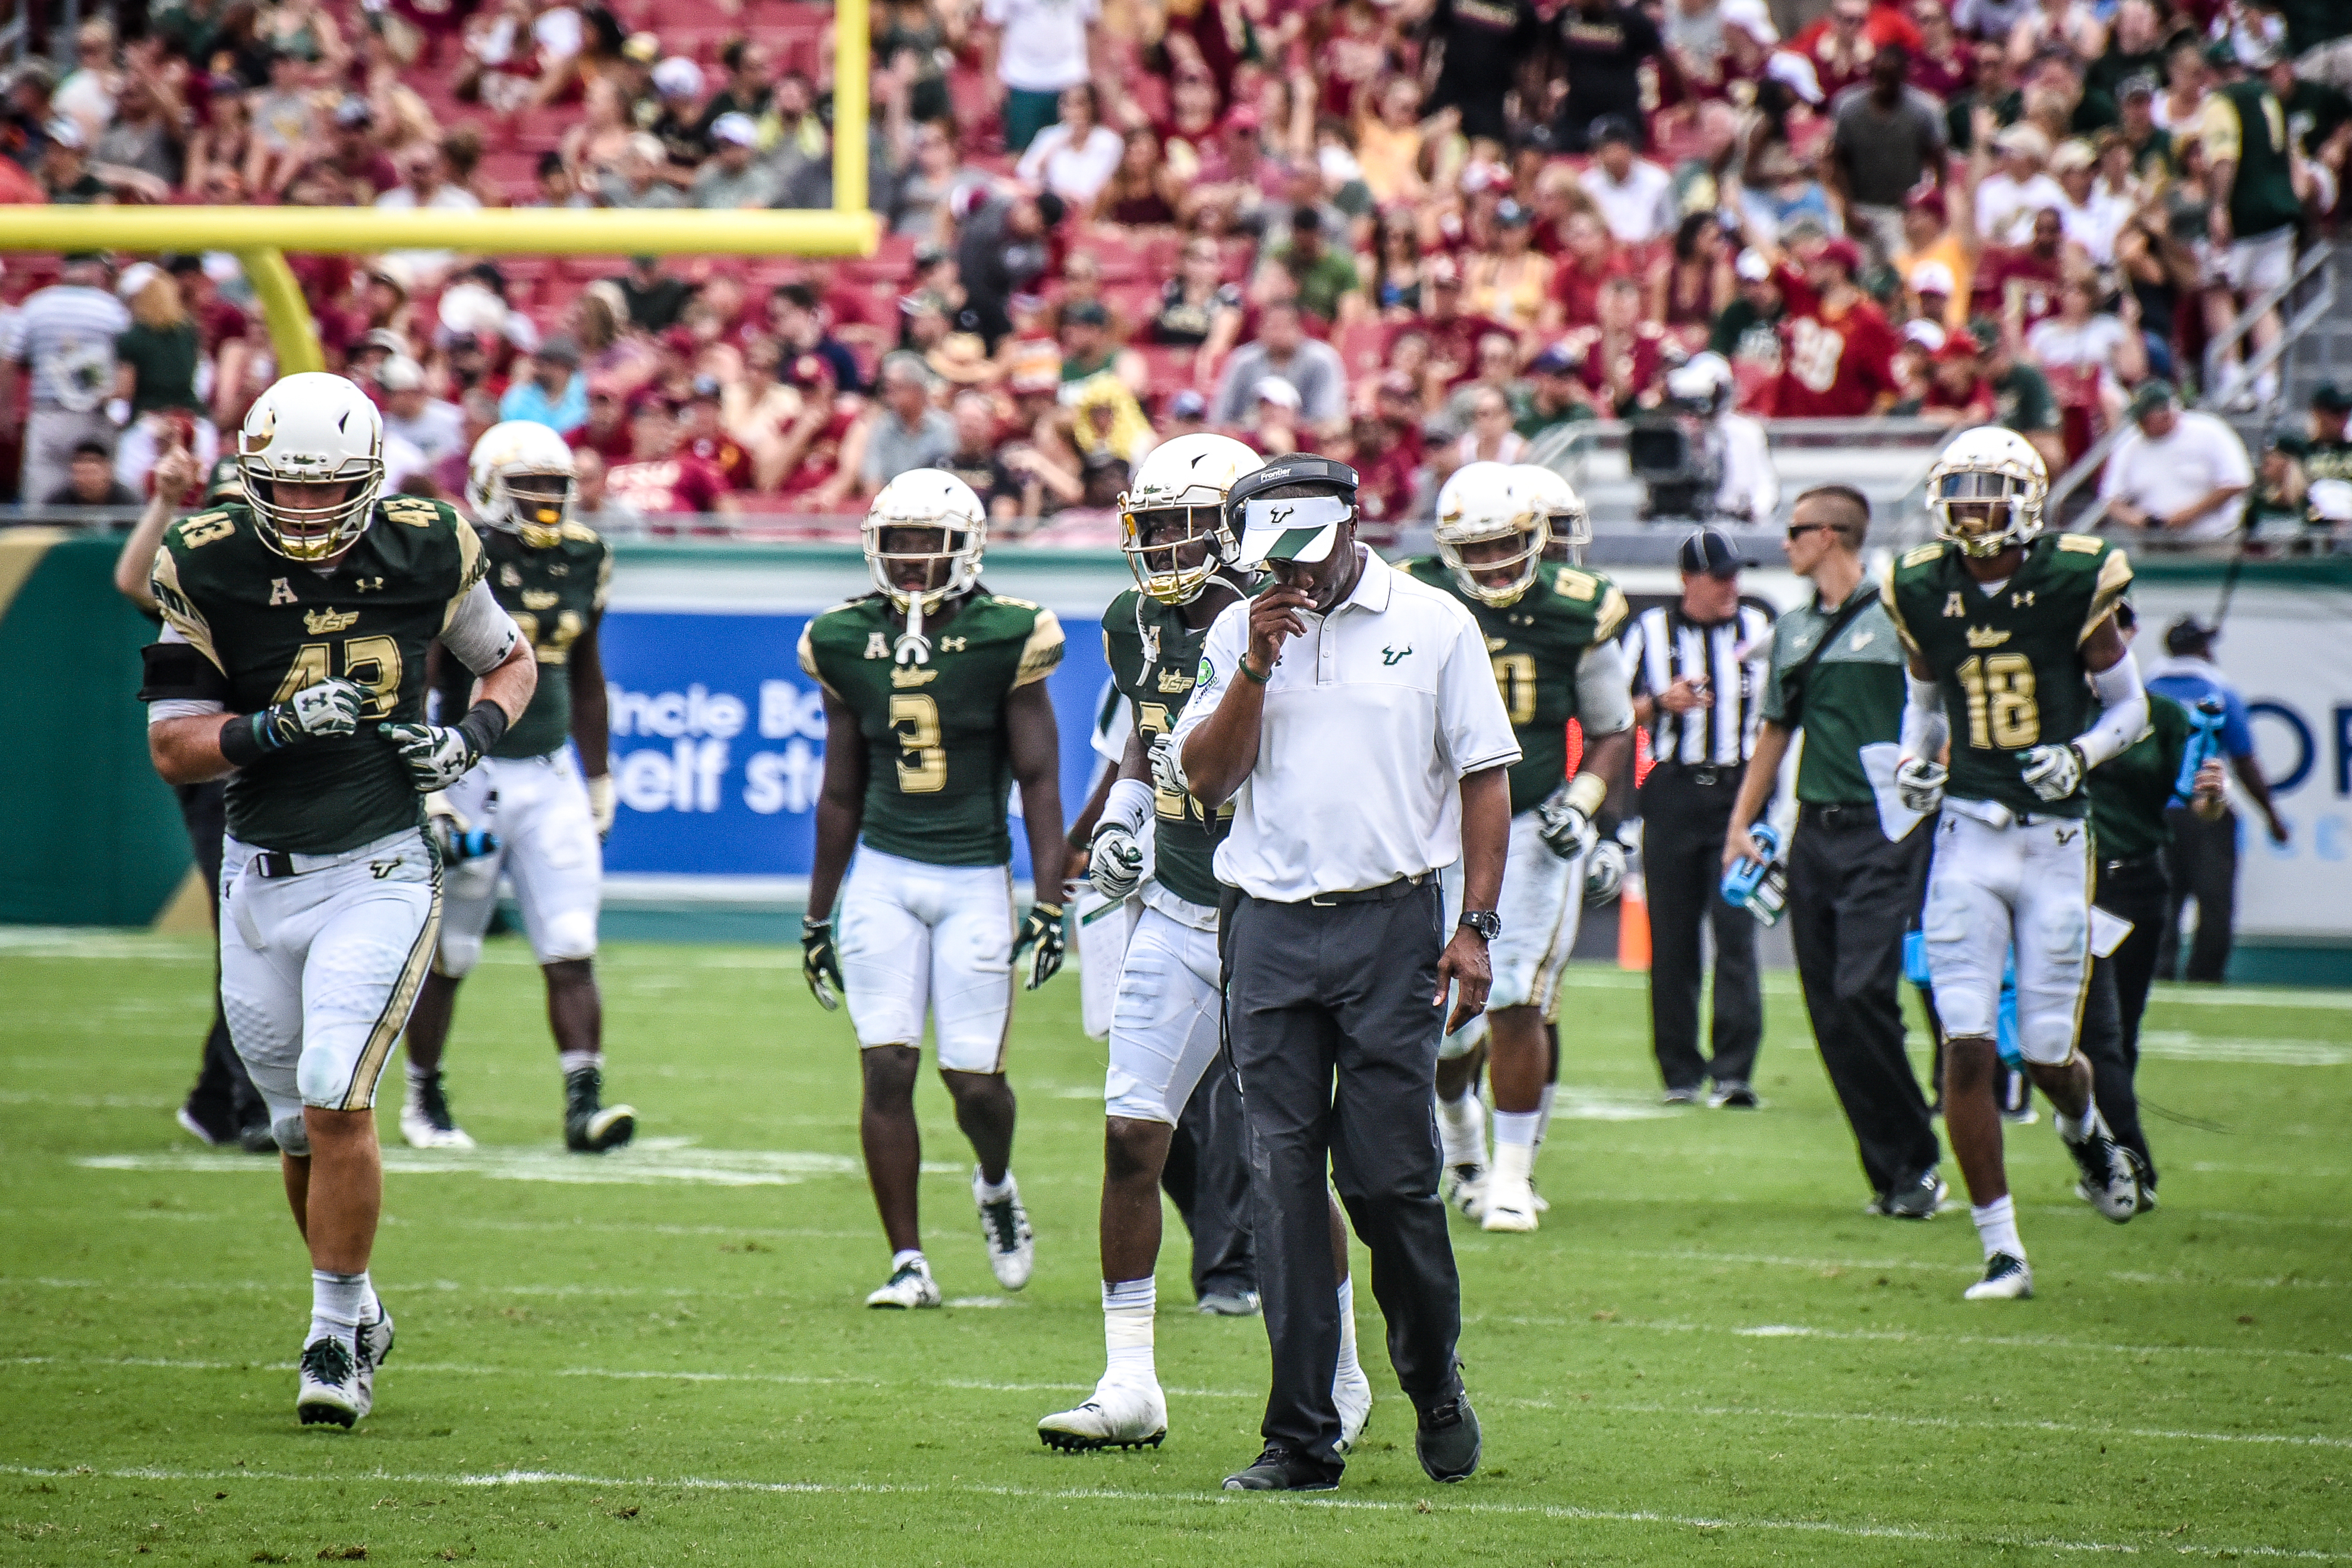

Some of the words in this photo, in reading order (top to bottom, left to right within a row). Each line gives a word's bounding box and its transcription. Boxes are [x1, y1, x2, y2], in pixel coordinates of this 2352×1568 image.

[1260, 467, 1292, 483] Frontier
[888, 692, 947, 793] 3
[1956, 653, 2041, 750] 18
[607, 738, 727, 813] elf
